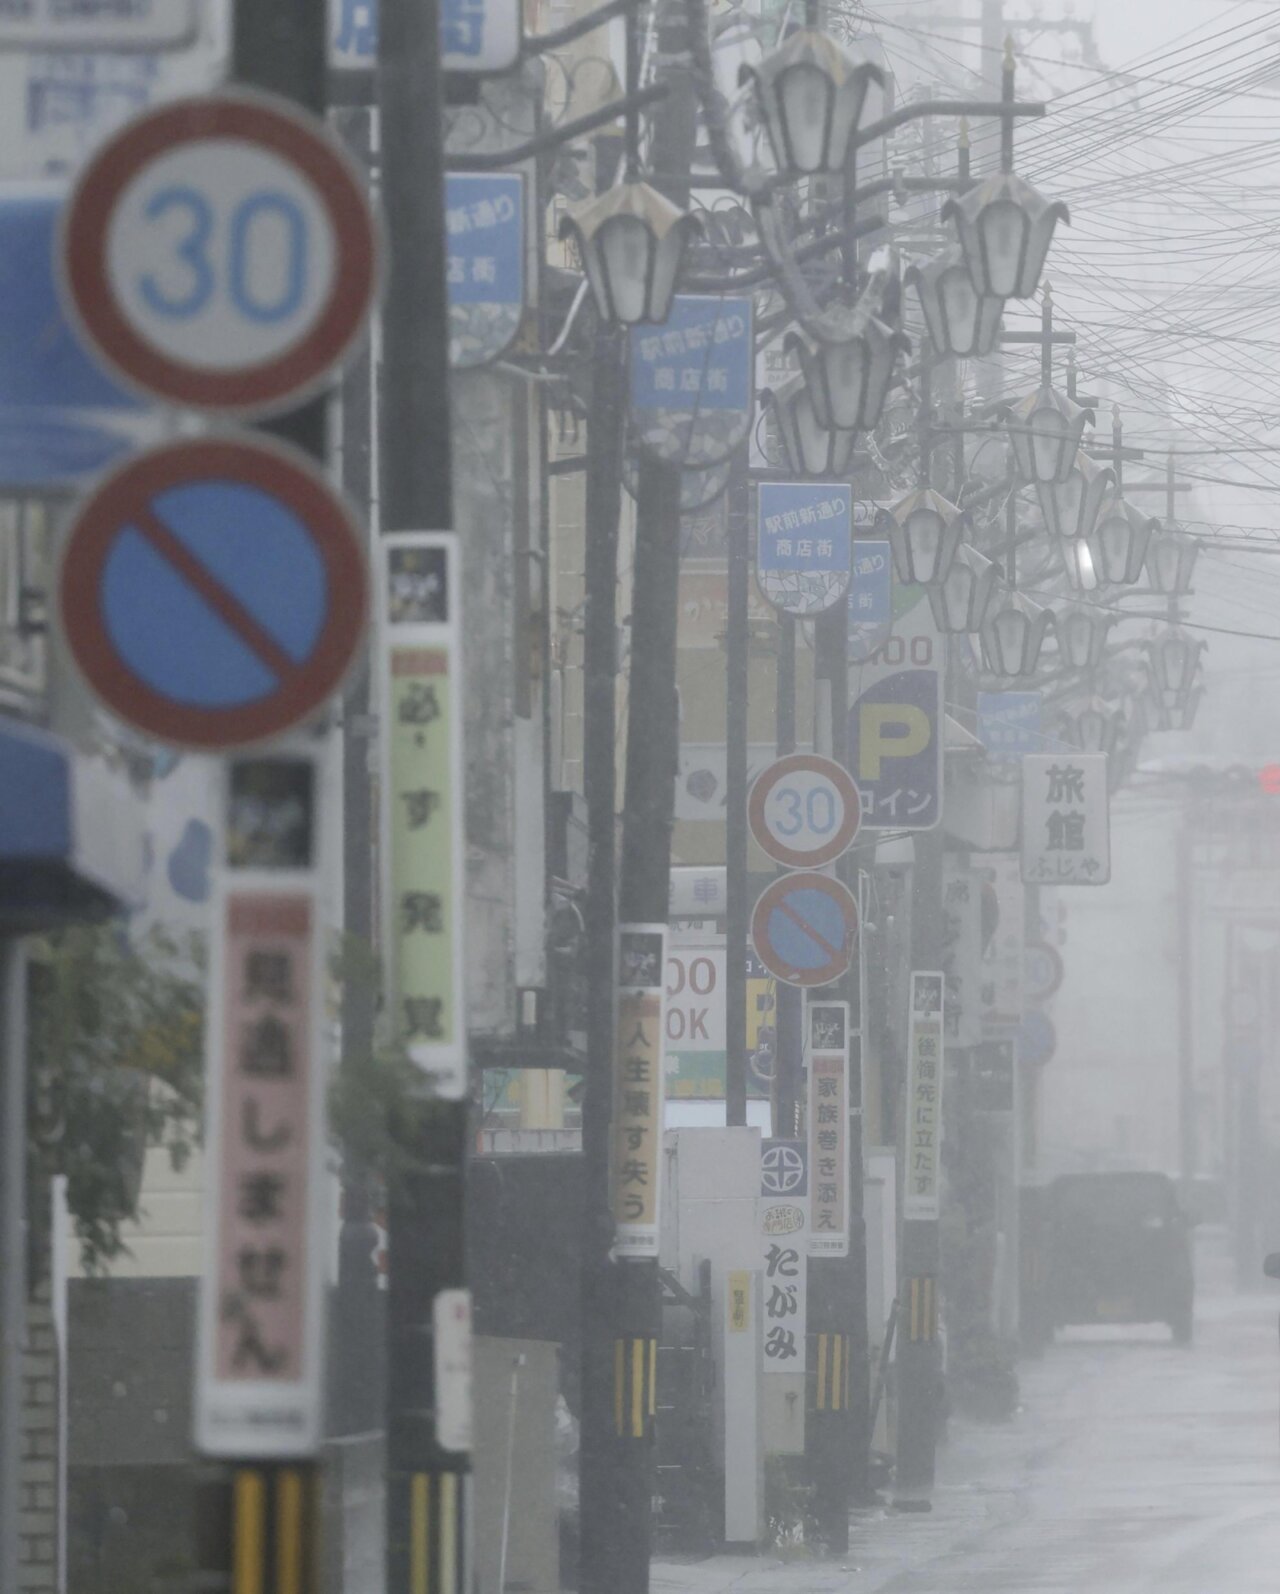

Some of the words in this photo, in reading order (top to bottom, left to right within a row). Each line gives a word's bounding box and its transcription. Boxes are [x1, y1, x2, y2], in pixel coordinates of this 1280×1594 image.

[140, 185, 309, 324] 30
[654, 368, 728, 392] 商店街
[764, 497, 846, 535] 駅前新通り
[776, 538, 832, 558] 商店街
[860, 703, 931, 781] P
[775, 786, 835, 836] 30
[1046, 764, 1086, 851] 旅館
[1030, 857, 1100, 878] ふじや
[817, 1076, 839, 1230] 家族巻き添え
[764, 1243, 799, 1360] たがみ
